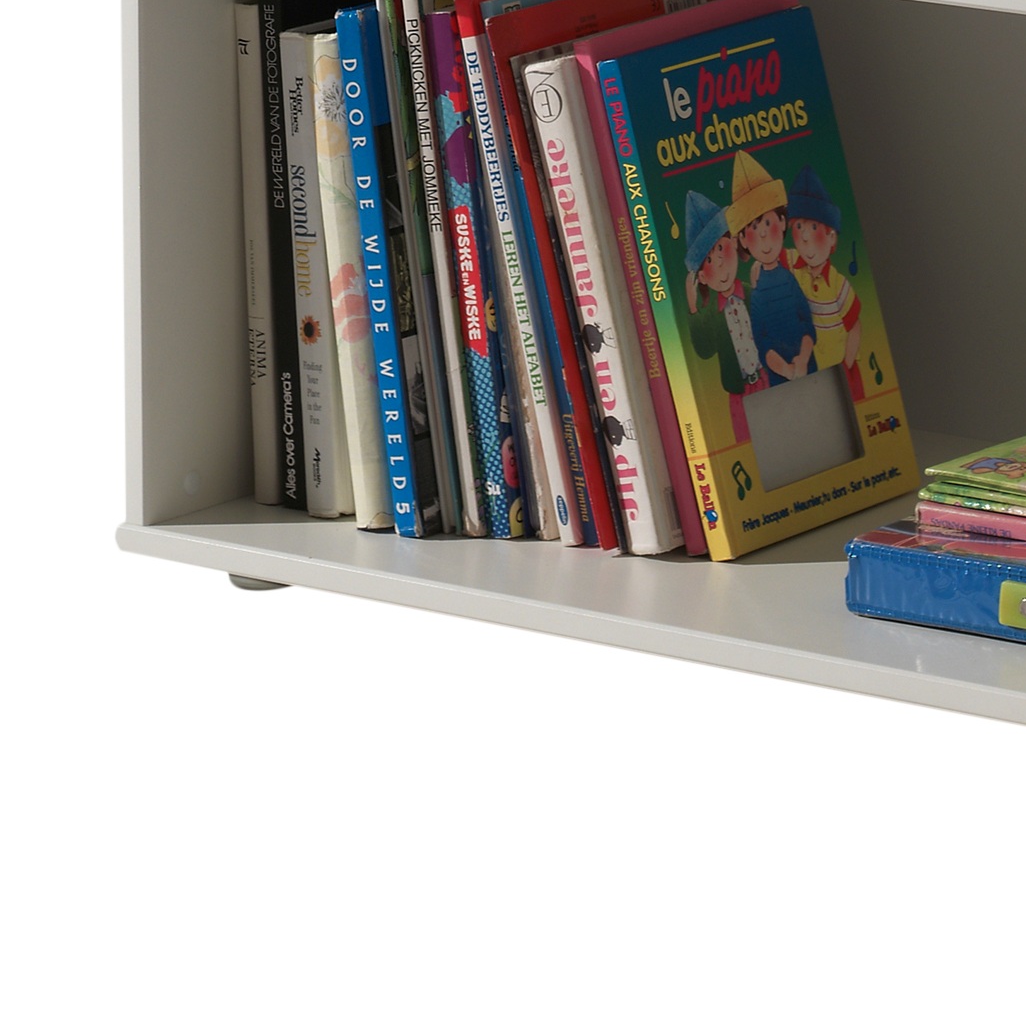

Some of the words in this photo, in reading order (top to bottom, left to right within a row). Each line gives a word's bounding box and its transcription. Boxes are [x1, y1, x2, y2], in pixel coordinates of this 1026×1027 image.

[263, 4, 279, 84] FOTOGRAFIE
[406, 18, 429, 113] PICKNICKEN
[466, 51, 481, 75] DE
[267, 86, 280, 103] DE
[289, 89, 300, 134] Homes
[295, 77, 304, 116] Better
[342, 58, 367, 149] DOOR
[604, 77, 620, 96] LE
[661, 77, 694, 123] le
[695, 47, 782, 134] piano
[269, 104, 281, 134] VAN
[417, 118, 433, 150] MET
[609, 101, 634, 158] PIANO
[656, 130, 702, 168] aux
[703, 98, 809, 154] chansons
[270, 135, 284, 190] WERELD
[472, 78, 511, 223] TEDDYBEERTJES
[273, 190, 286, 209] DE
[356, 175, 375, 210] DE
[421, 155, 443, 233] JOMMEKE
[622, 163, 643, 200] AUX
[455, 213, 474, 272] SUSKE
[501, 230, 523, 287] LEREN
[617, 217, 638, 278] vriendjes
[633, 204, 667, 303] CHANSONS
[363, 234, 389, 333] WIJDE
[461, 271, 470, 286] EN
[630, 281, 645, 305] zijn
[464, 284, 482, 341] WISKE
[513, 290, 531, 327] HET
[638, 309, 649, 326] en
[255, 328, 267, 378] ANIMA
[521, 330, 548, 407] ALFABET
[641, 329, 661, 380] Beertje
[280, 371, 294, 436] Camera's
[595, 361, 617, 412] en
[379, 358, 407, 490] WERELD
[285, 438, 296, 467] over
[562, 414, 583, 473] Uitgeverij
[574, 476, 590, 523] Hemma
[285, 469, 297, 500] Alles
[395, 501, 411, 515] 5
[614, 454, 639, 522] Jip
[762, 507, 790, 526] Jacques
[832, 486, 848, 500] dors
[850, 480, 863, 493] Sur
[863, 476, 871, 488] le
